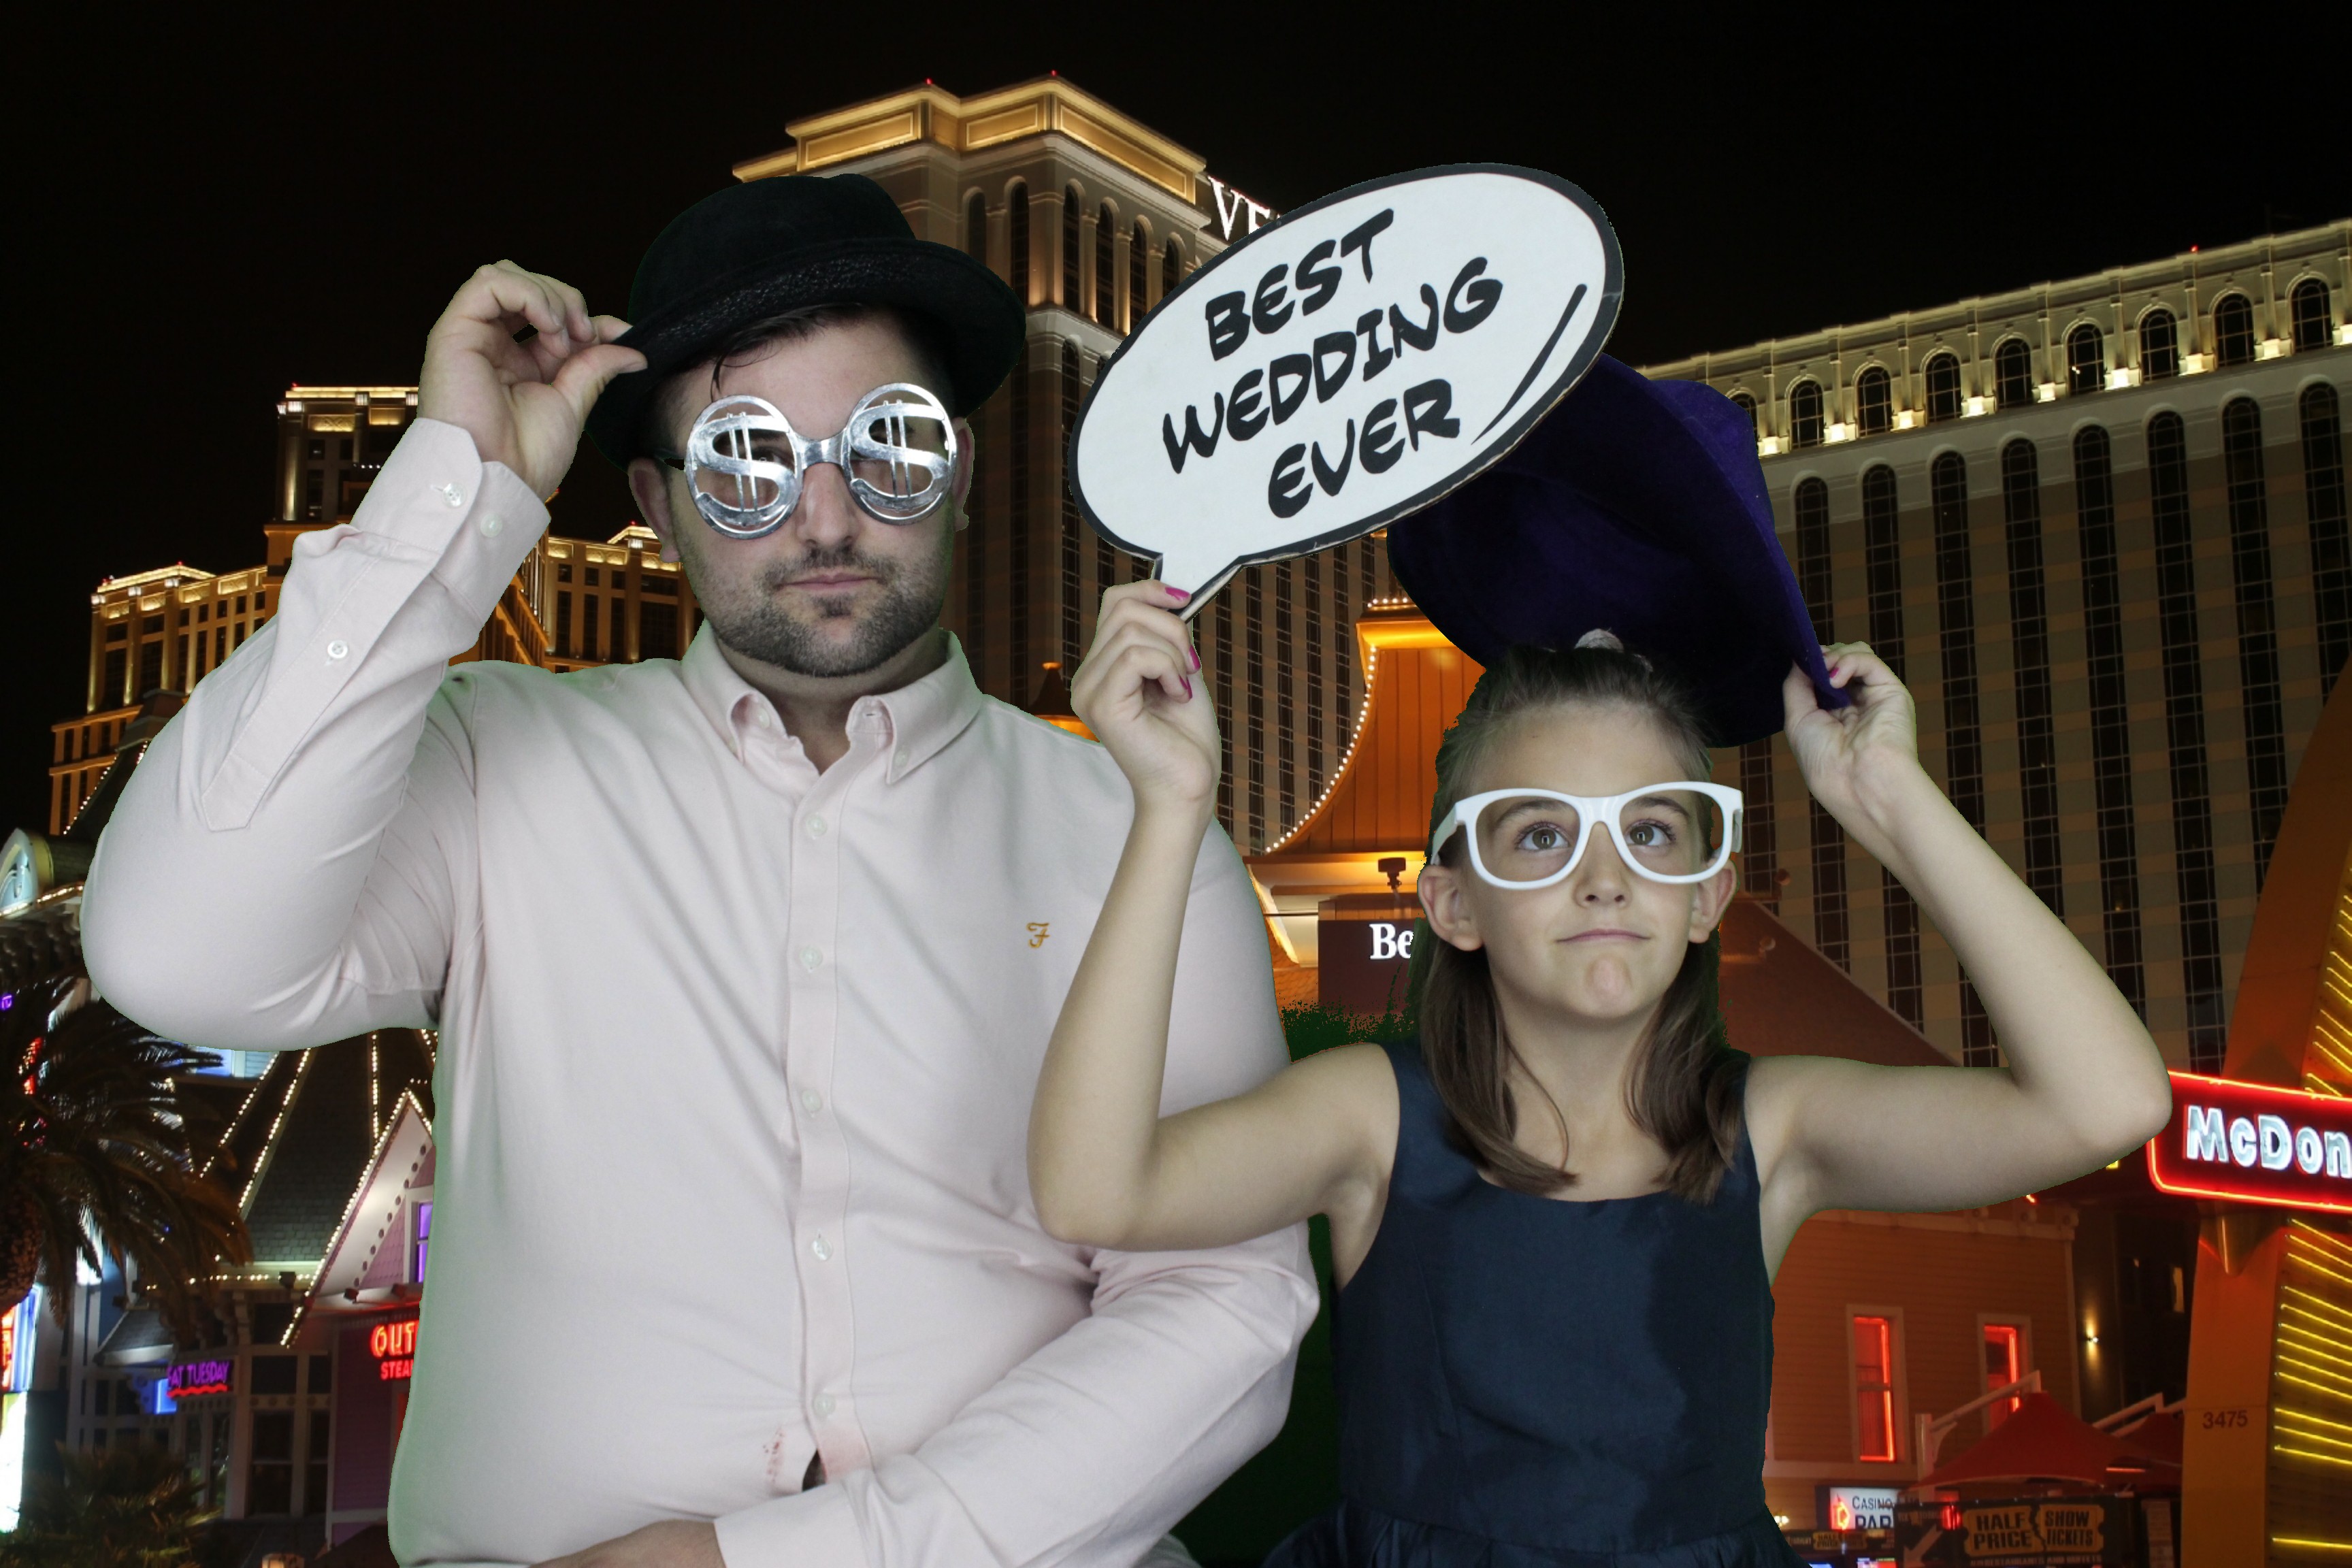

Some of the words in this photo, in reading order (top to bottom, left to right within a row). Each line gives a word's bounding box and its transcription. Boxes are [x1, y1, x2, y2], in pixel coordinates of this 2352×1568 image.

[1207, 176, 1281, 241] VE
[1205, 208, 1394, 361] BEST
[1162, 257, 1503, 474] WEDDING
[1267, 378, 1460, 519] EVER
[2183, 1105, 2352, 1179] McDon
[187, 1360, 229, 1386] TUESDAY
[2202, 1410, 2248, 1429] 3475
[1974, 1530, 2031, 1550] PRICE
[2047, 1529, 2093, 1546] TICKETS
[1976, 1512, 2025, 1531] HALF
[2045, 1511, 2089, 1527] SHOW
